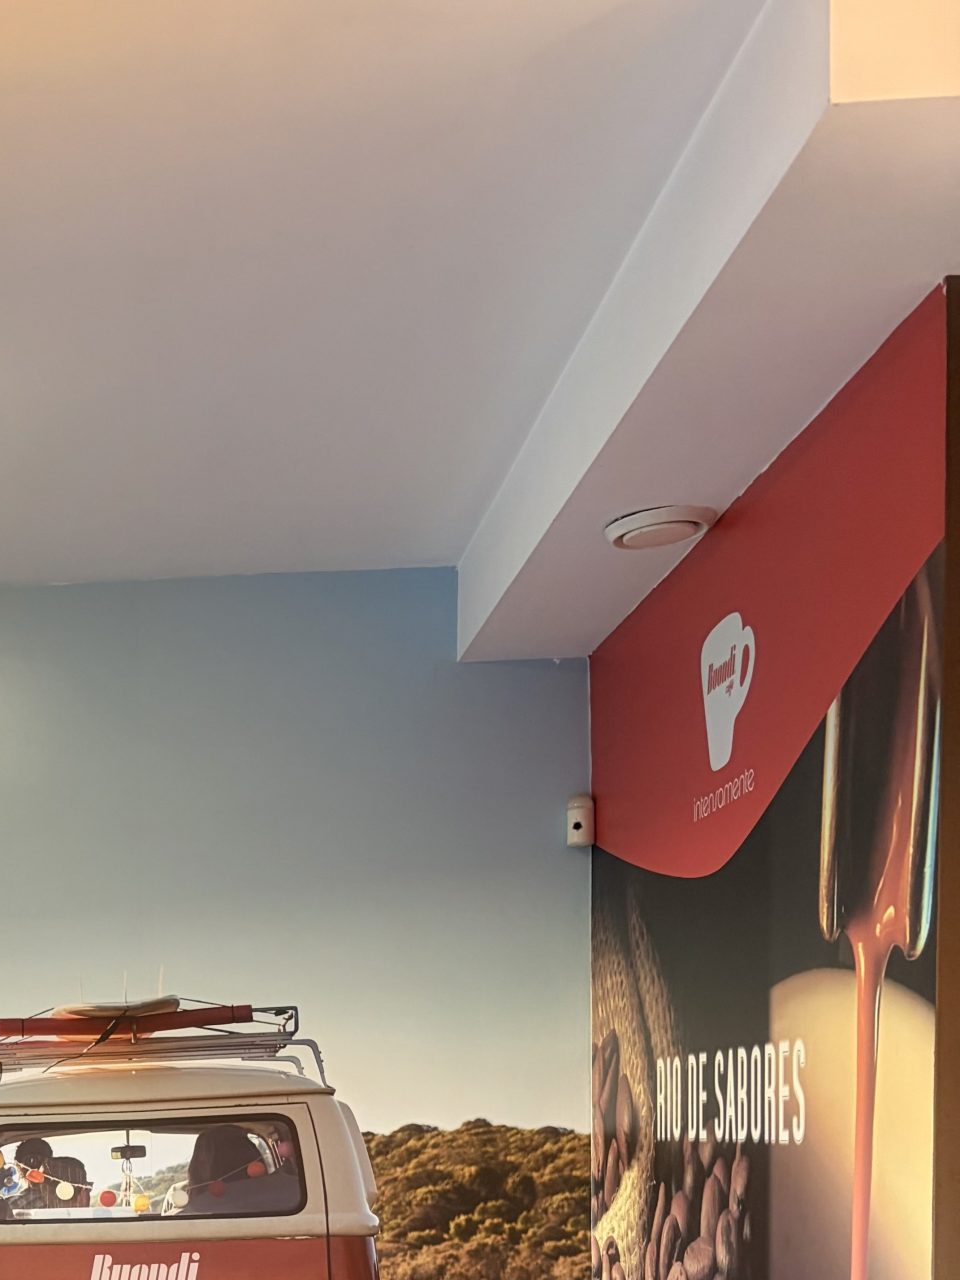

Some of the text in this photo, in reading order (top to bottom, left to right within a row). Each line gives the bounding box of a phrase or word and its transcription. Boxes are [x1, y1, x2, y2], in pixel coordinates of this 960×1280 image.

[707, 644, 737, 696] Buondi
[693, 768, 756, 822] intensamente
[656, 1038, 807, 1145] RIO DE SABORES
